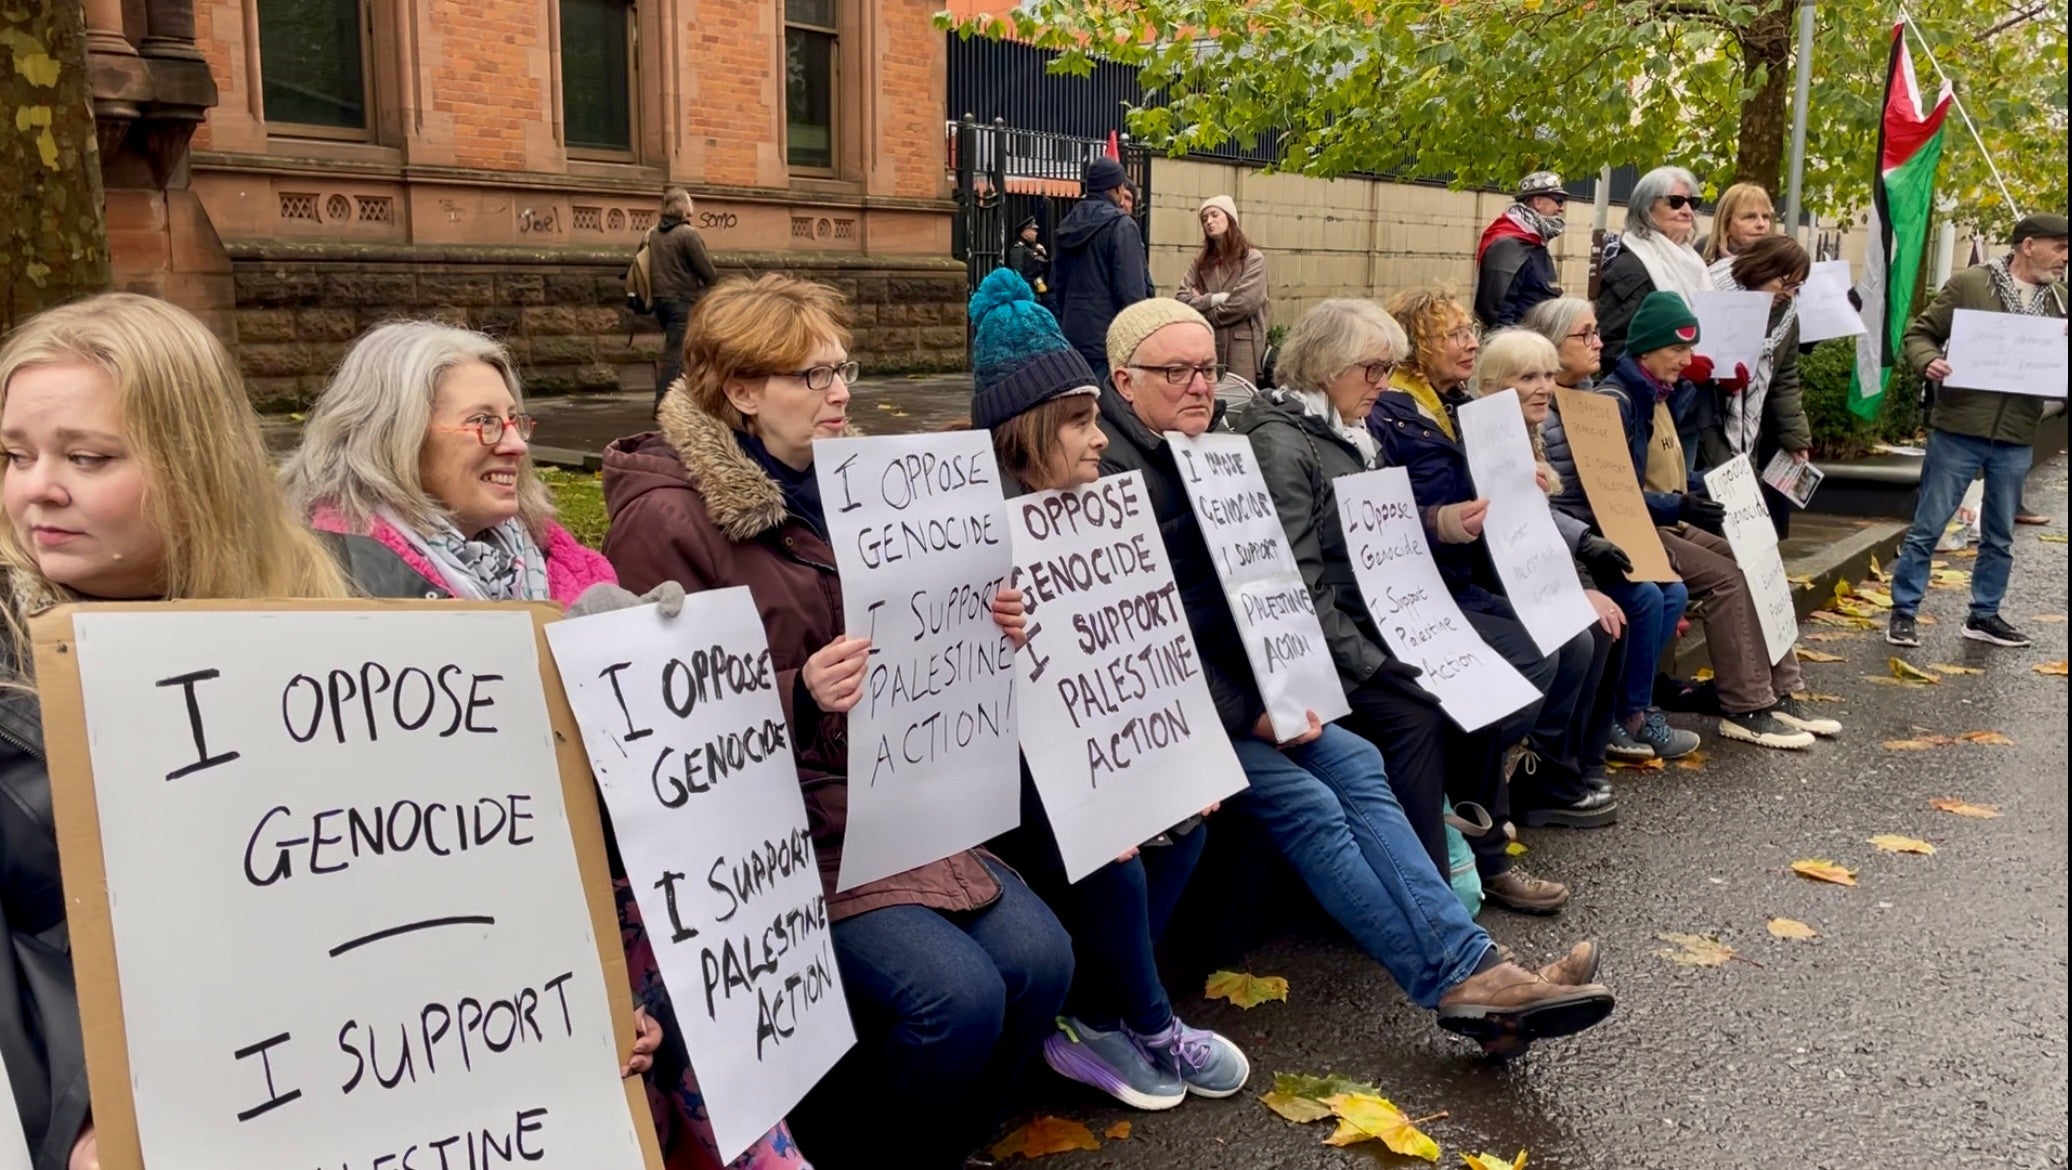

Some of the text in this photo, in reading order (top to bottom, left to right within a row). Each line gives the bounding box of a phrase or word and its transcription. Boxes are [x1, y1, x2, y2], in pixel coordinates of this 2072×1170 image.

[834, 450, 989, 513] I OPPOSE
[1181, 450, 1202, 483] I
[858, 514, 999, 569] GENOCIDE
[1022, 476, 1139, 541] OPPOSE
[1199, 491, 1272, 530] GENOCIDE
[1343, 498, 1413, 536] I Oppose
[1011, 534, 1156, 615] GENOCIDE
[1222, 538, 1278, 576] I SUPPORT
[1360, 534, 1423, 570] Genocide
[868, 576, 1004, 656] I SUPPORT
[1014, 581, 1179, 684] I SUPPORT
[1240, 588, 1316, 627] PALESTINE
[1370, 586, 1428, 626] I Support
[1395, 616, 1458, 652] Palestine
[599, 644, 772, 742] I OPPOSE
[869, 634, 1012, 720] PALESTINE
[1057, 634, 1199, 729] PALESTINE
[1263, 632, 1312, 674] ACTION
[1422, 652, 1482, 686] Action
[156, 661, 504, 781] I OPPOSE
[871, 679, 1013, 788] ACTION!
[1085, 700, 1191, 788] ACTION
[651, 719, 787, 809] GENOCIDE
[243, 794, 534, 887] GENOCIDE
[653, 826, 811, 944] I SUPPORT
[701, 895, 826, 1022] PALESTINE
[756, 940, 832, 1062] ACTION
[234, 971, 573, 1122] I SUPPORT
